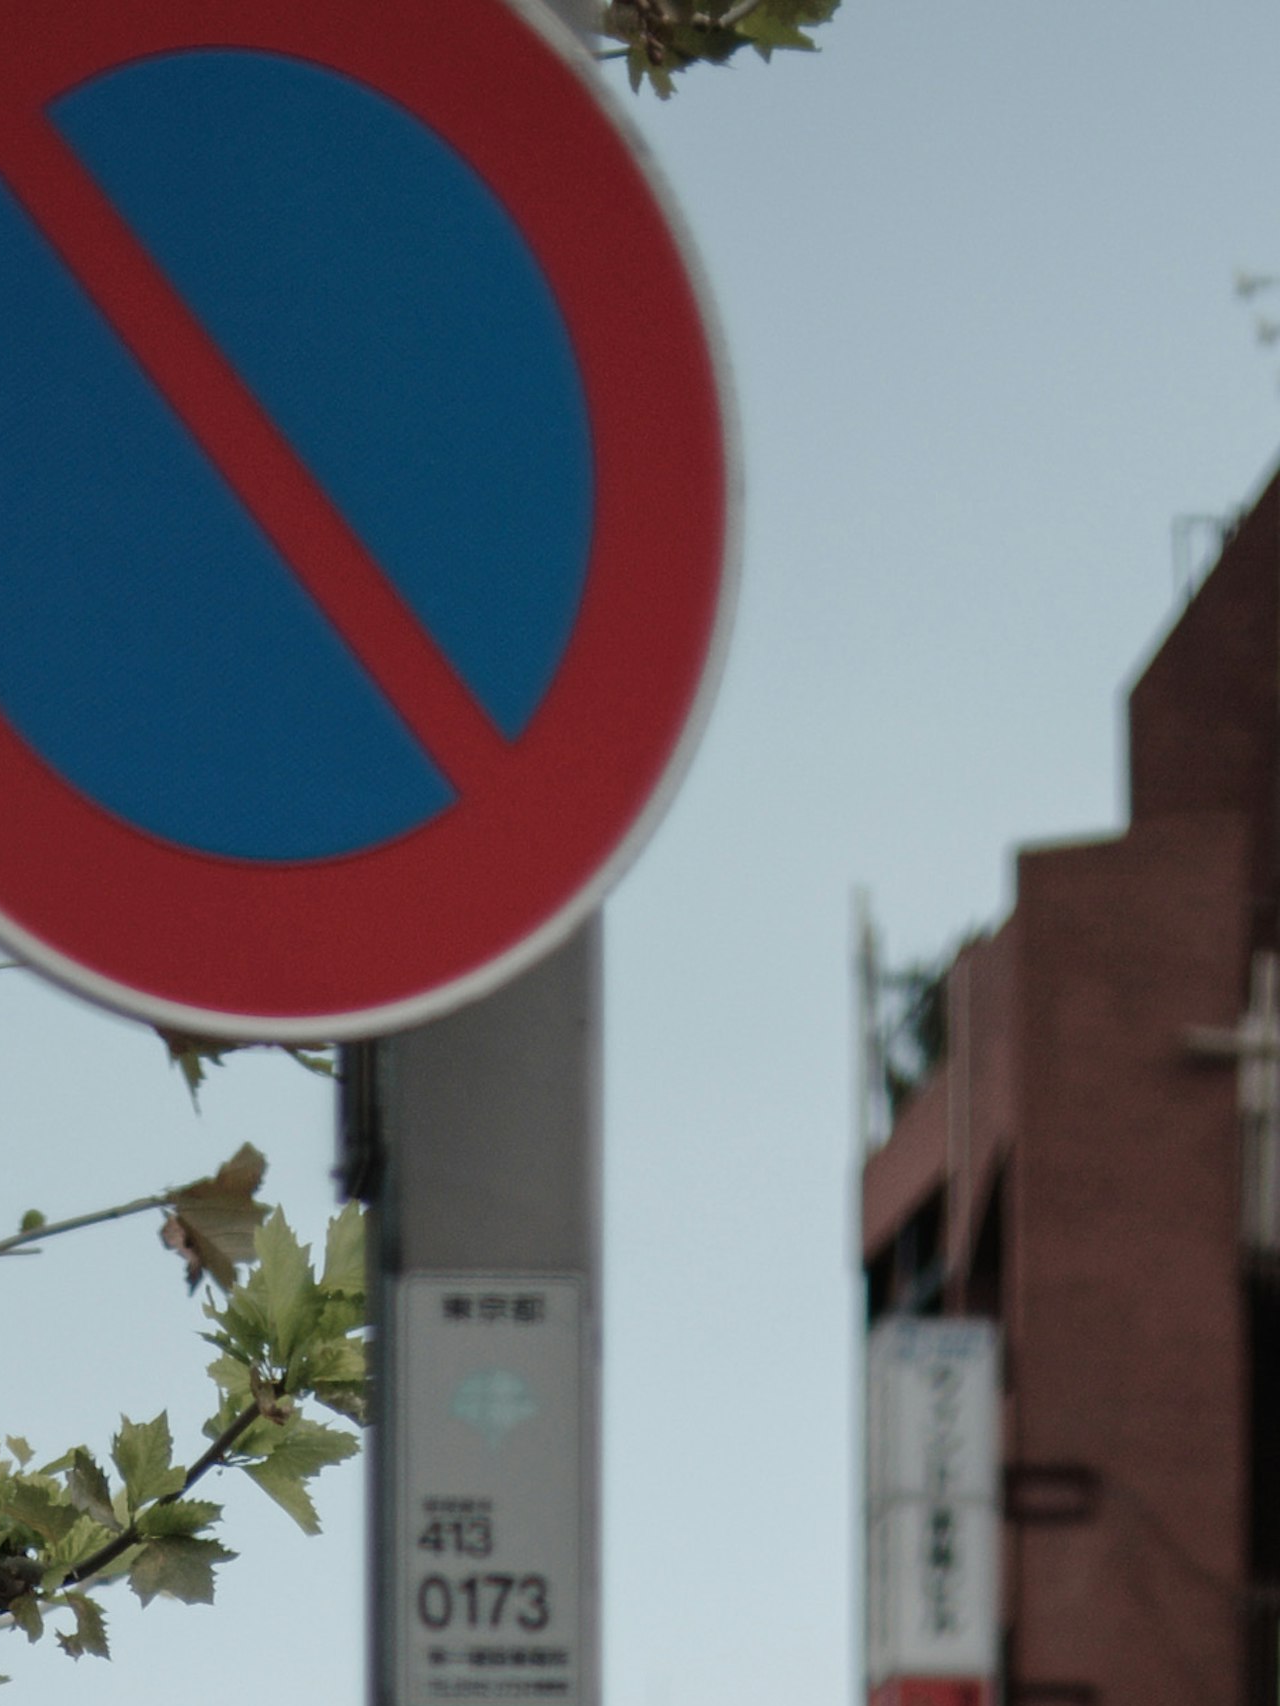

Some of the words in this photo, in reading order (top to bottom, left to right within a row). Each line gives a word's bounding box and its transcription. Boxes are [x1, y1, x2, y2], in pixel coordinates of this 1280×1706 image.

[442, 1292, 545, 1322] 東京都
[418, 1517, 492, 1557] 413
[417, 1574, 549, 1631] 0173
